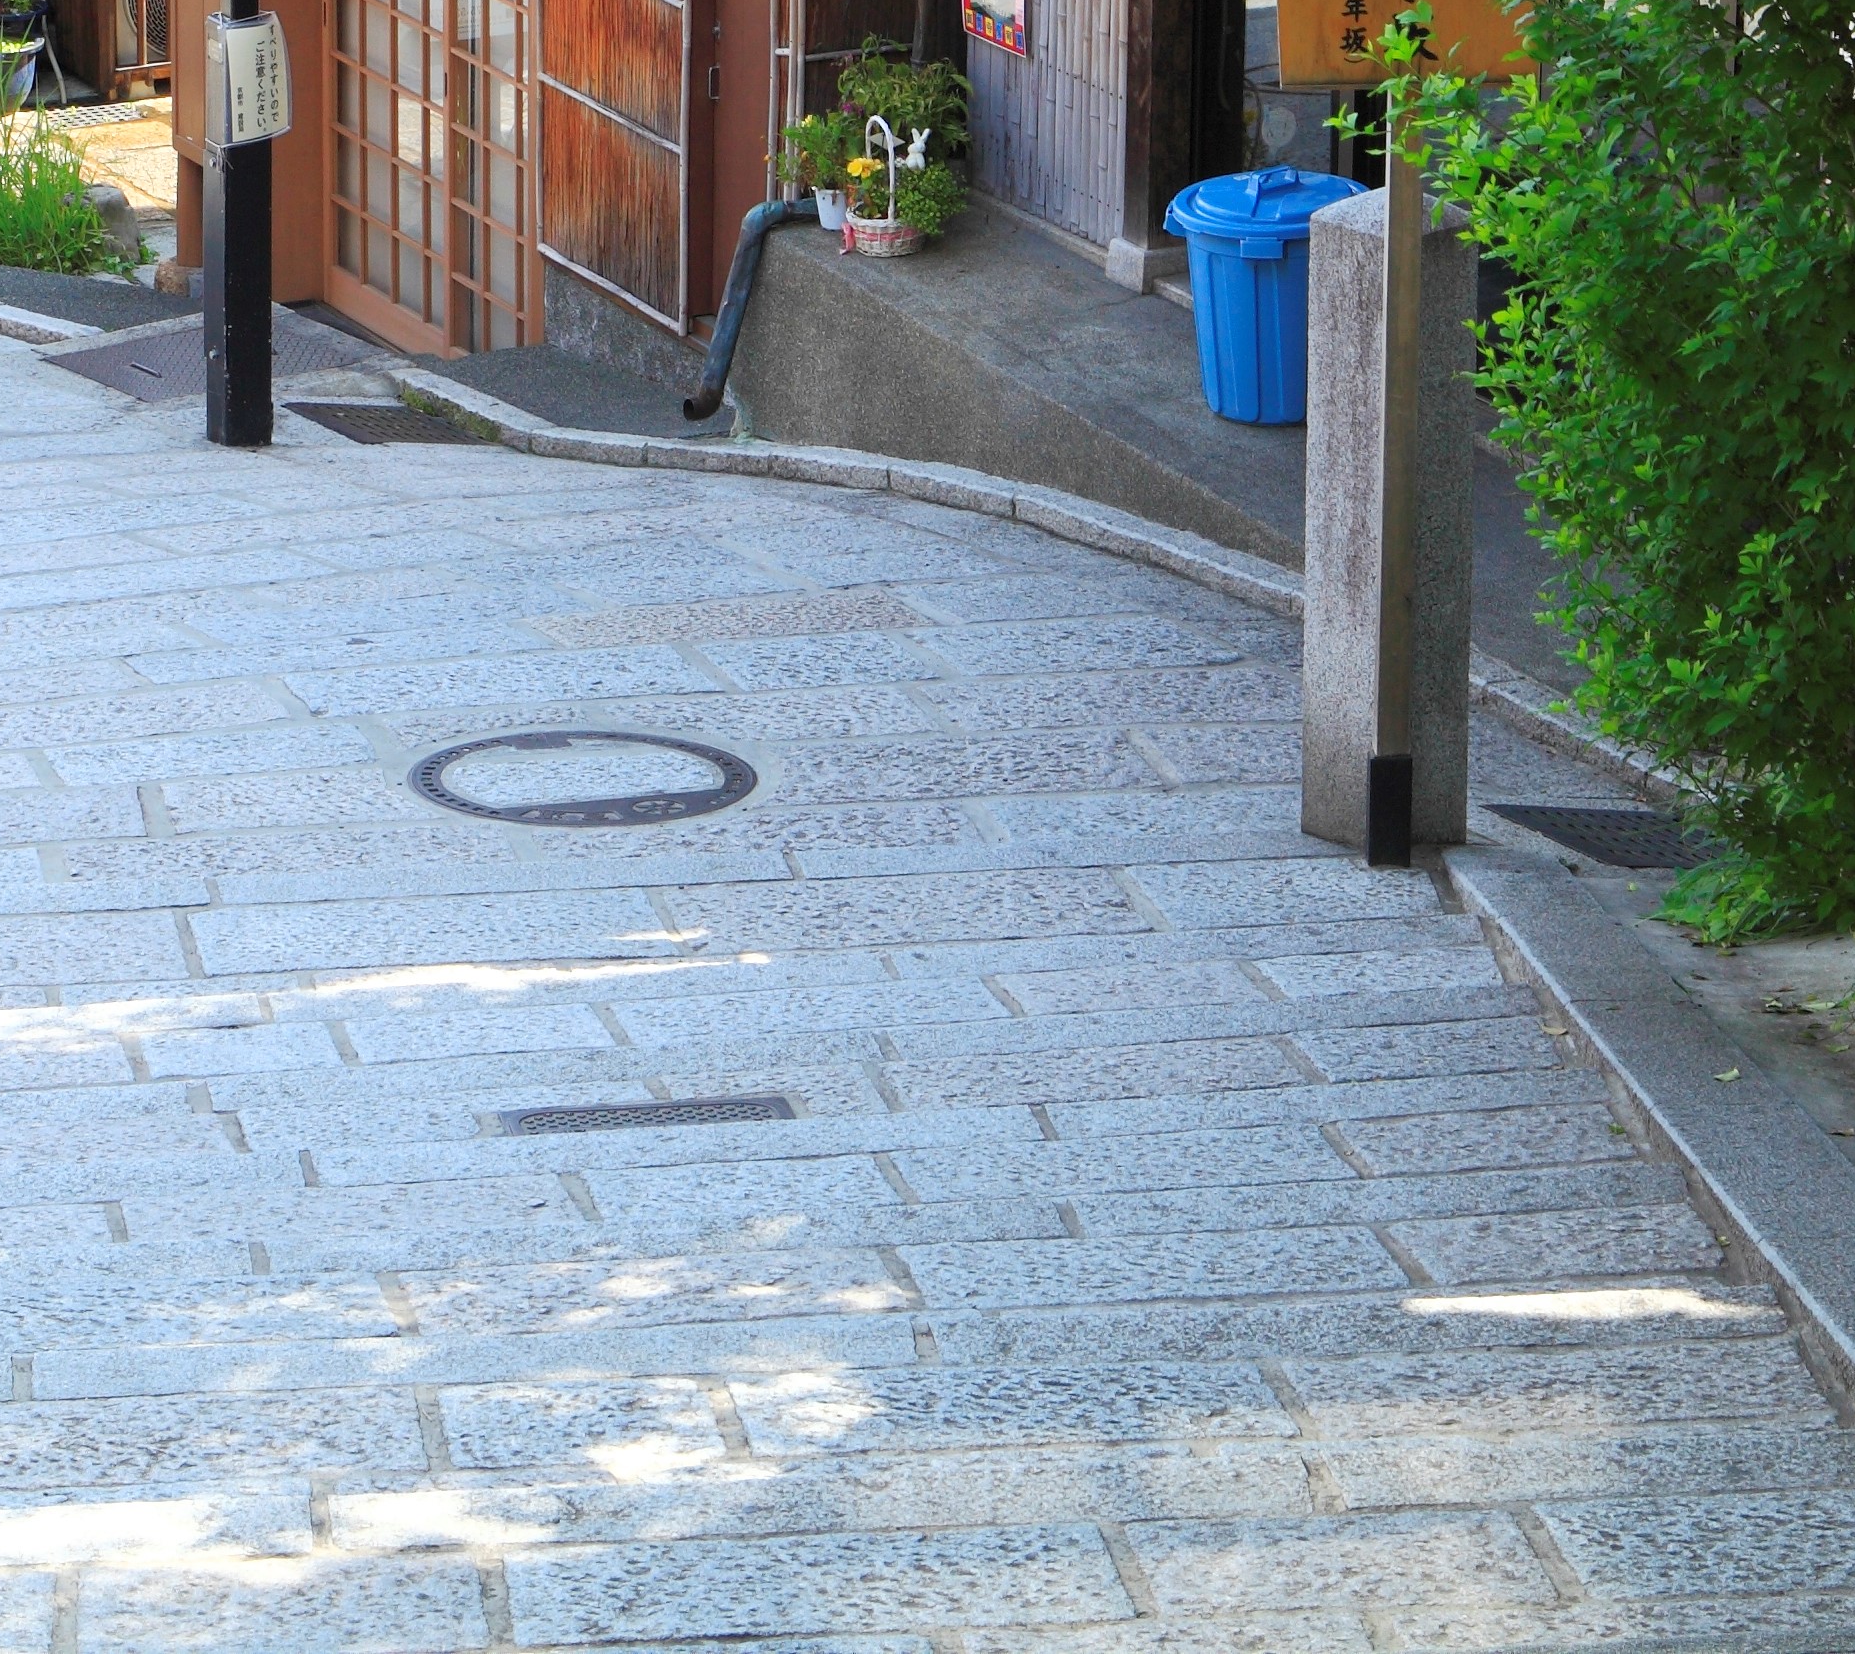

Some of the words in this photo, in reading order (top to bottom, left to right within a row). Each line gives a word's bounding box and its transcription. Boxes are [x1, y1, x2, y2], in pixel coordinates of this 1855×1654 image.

[256, 40, 266, 132] ご注意ください。
[269, 24, 279, 122] すべりやすいので
